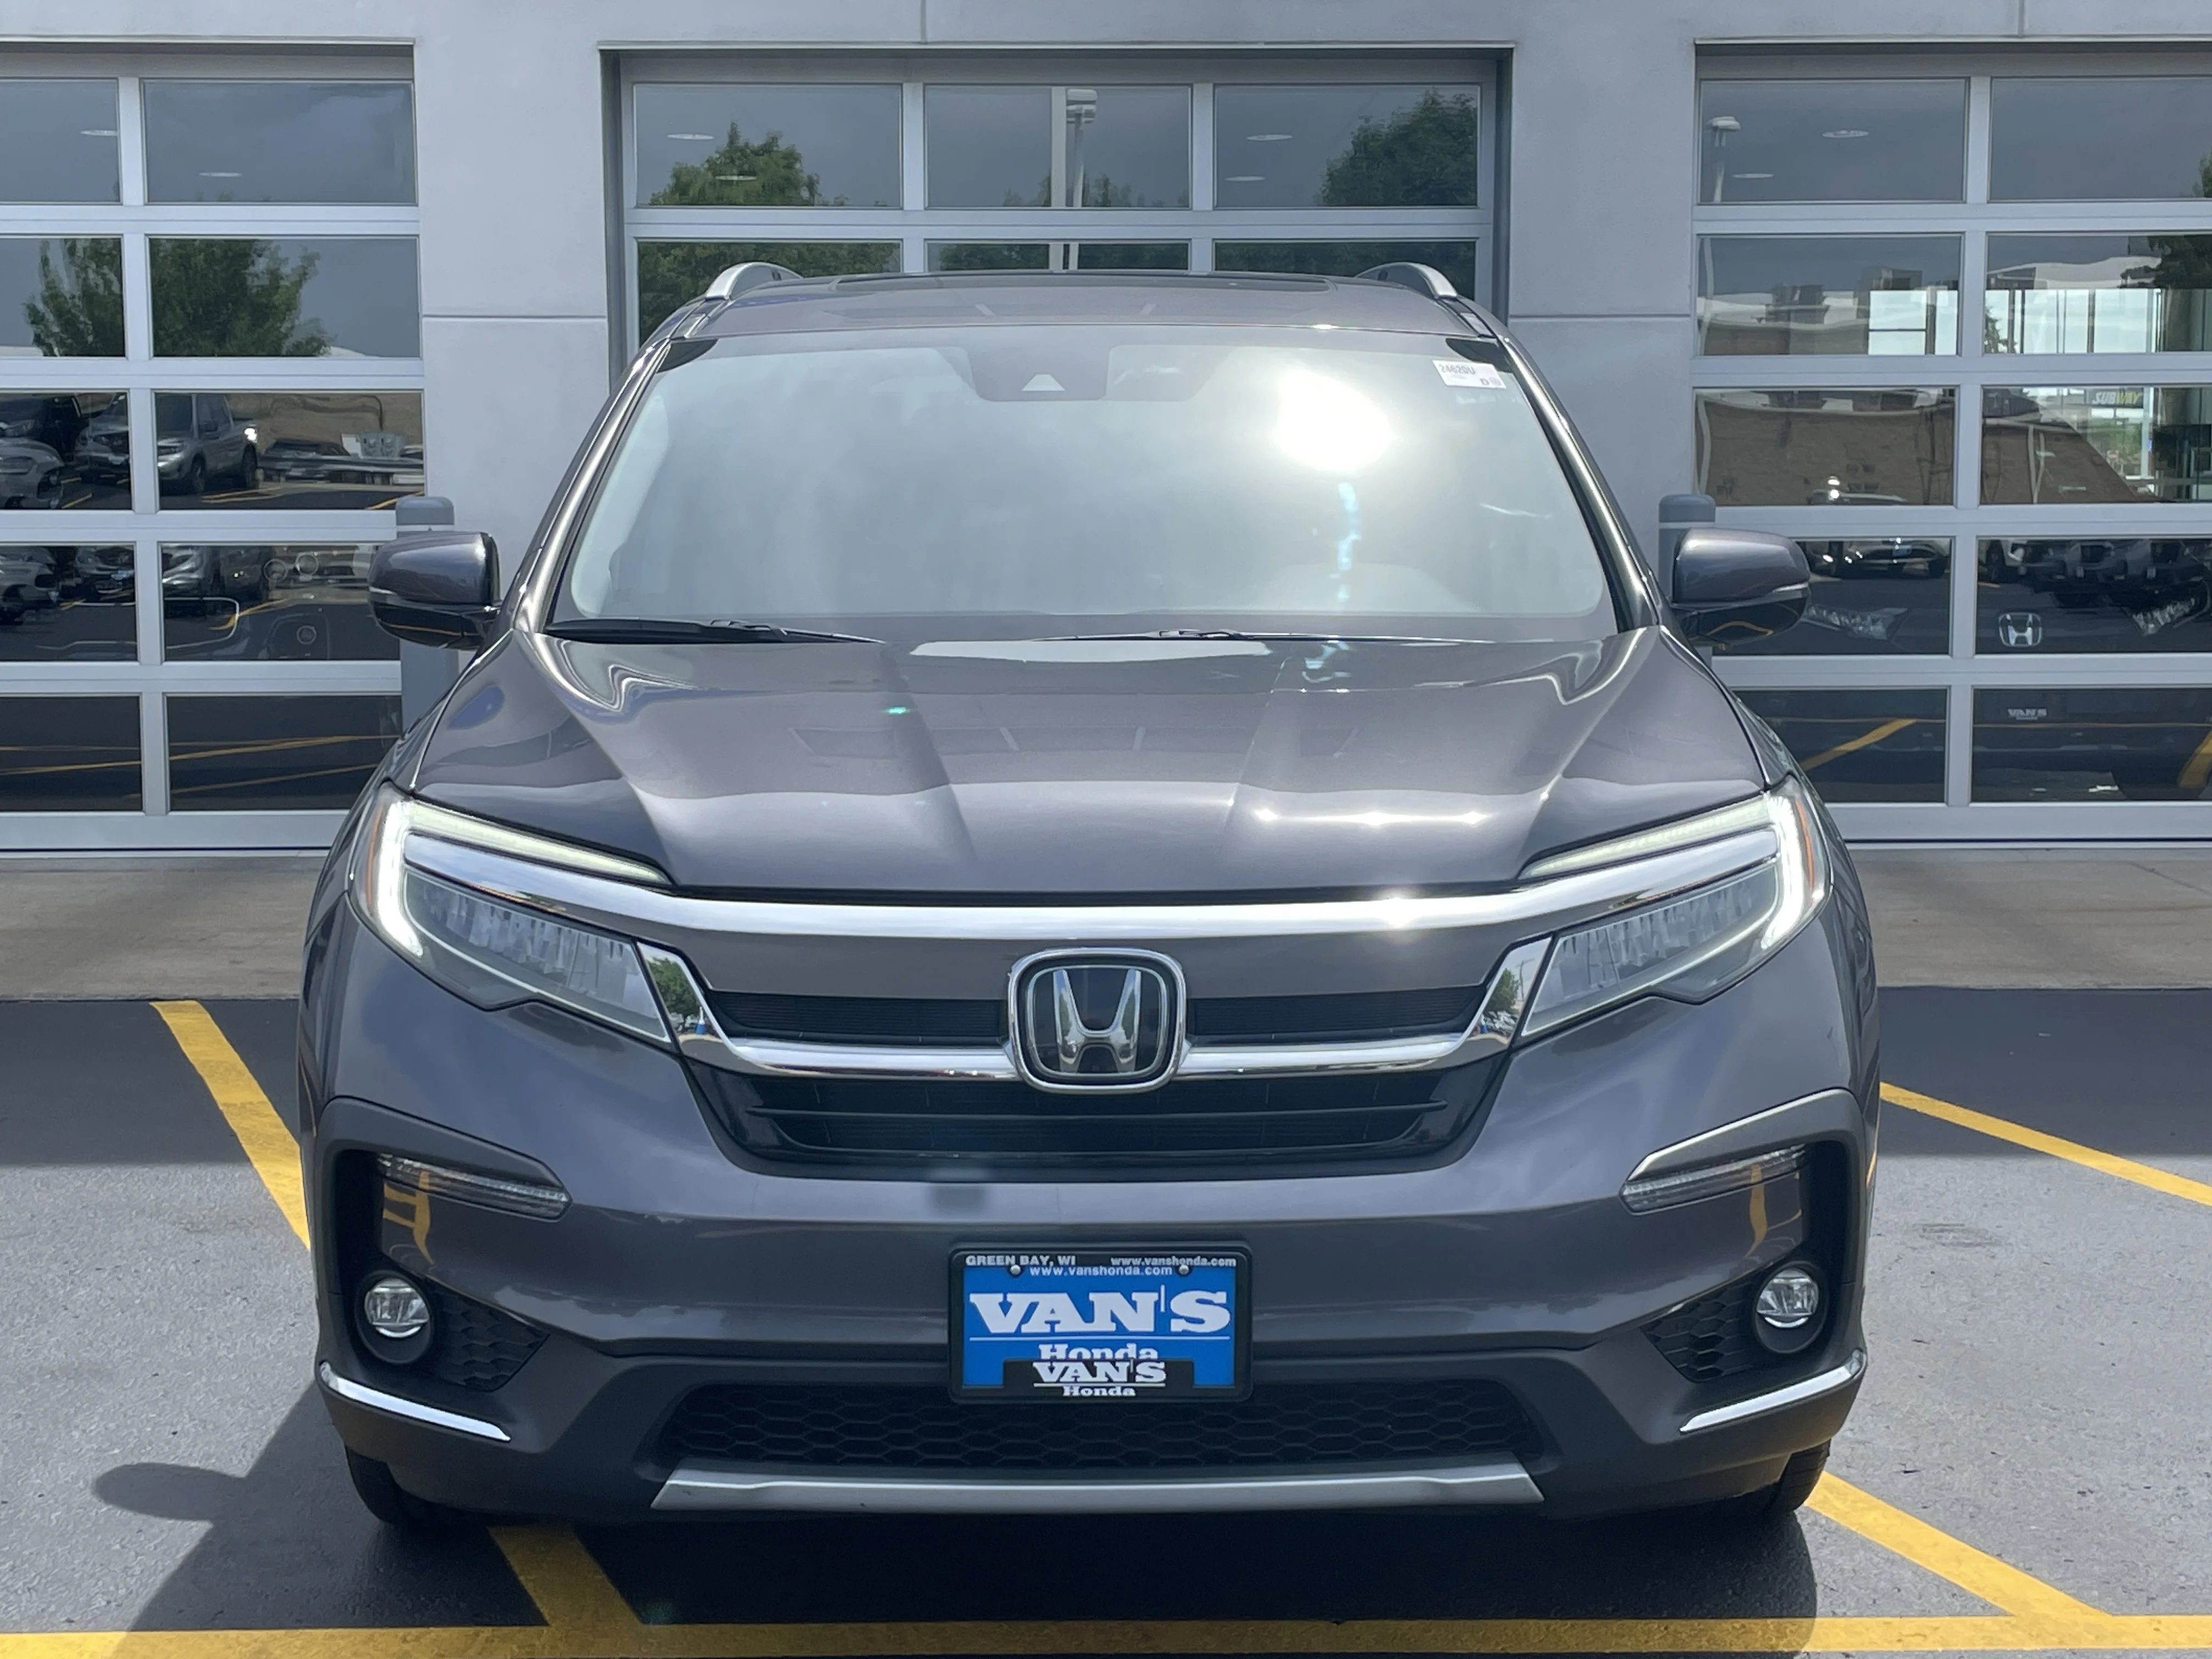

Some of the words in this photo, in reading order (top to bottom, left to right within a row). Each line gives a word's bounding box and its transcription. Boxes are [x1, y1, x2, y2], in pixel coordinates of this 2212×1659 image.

[2092, 391, 2143, 405] SUBWAY
[965, 1255, 1015, 1266] GREEN
[1019, 1255, 1054, 1267] BAY,
[1057, 1255, 1076, 1266] WI
[1110, 1255, 1237, 1267] www.vanshonda.com
[1029, 1265, 1173, 1277] www.vanshonda.com
[969, 1284, 1231, 1334] VAN'S
[1038, 1342, 1159, 1360] Honda
[1032, 1358, 1167, 1383] VAN'S
[1062, 1385, 1137, 1397] Honda
